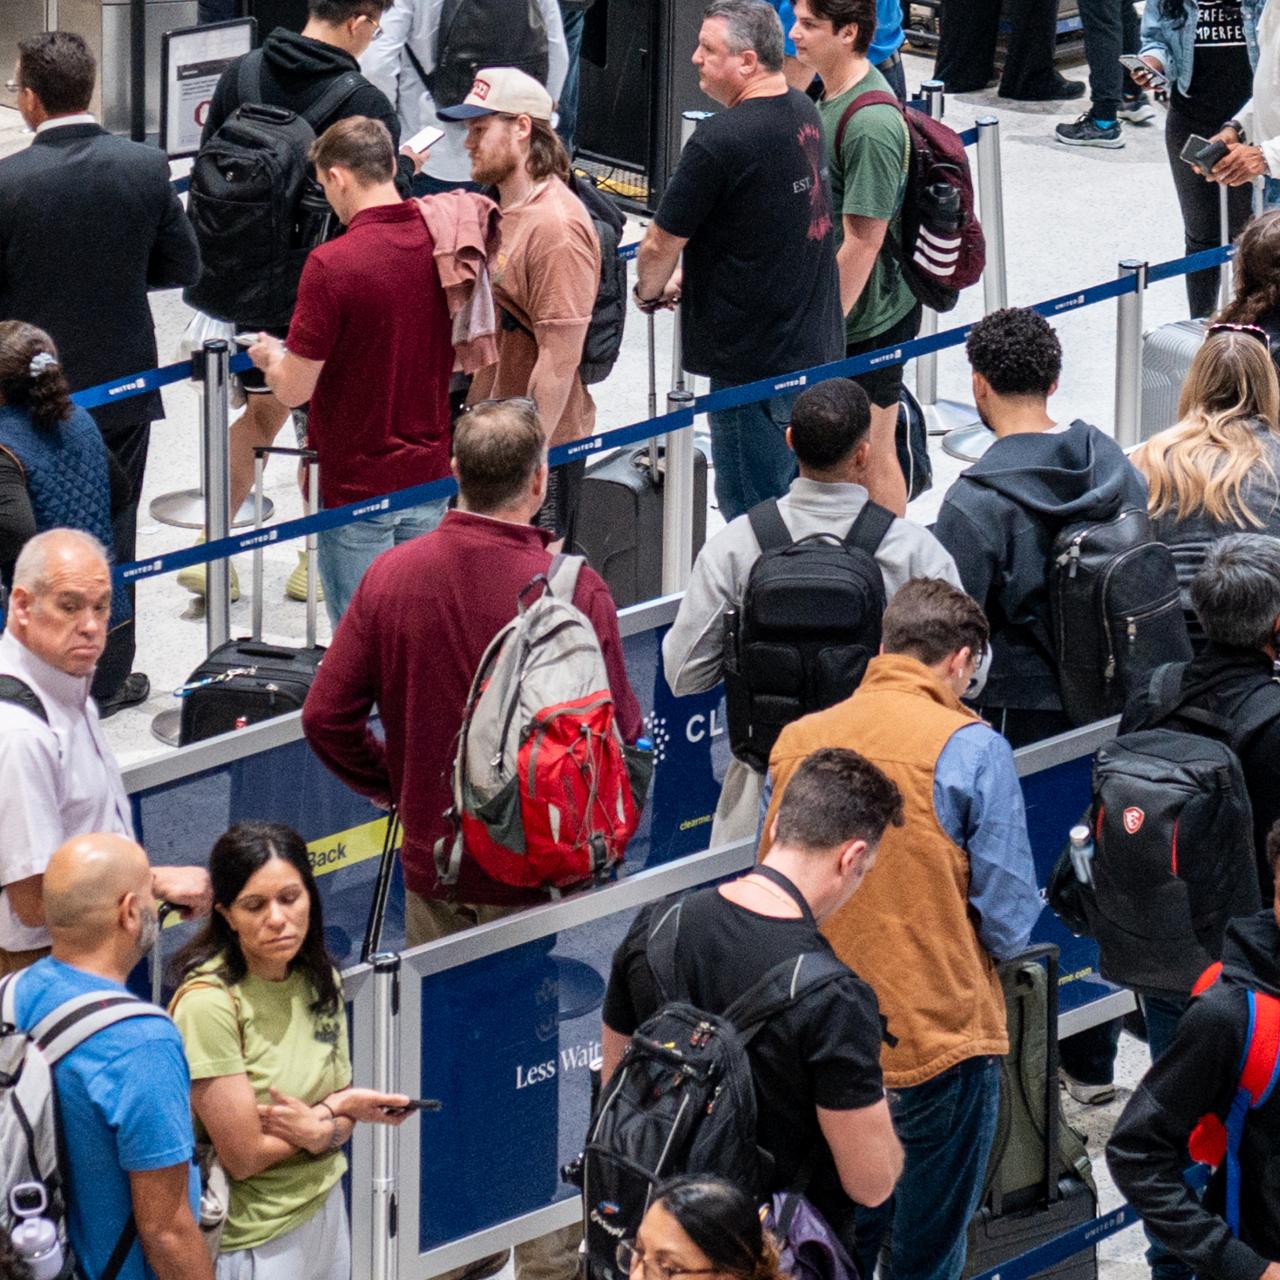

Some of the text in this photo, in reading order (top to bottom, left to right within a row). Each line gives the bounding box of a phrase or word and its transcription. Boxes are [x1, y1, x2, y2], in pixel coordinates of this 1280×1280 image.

[1196, 25, 1242, 40] MPERFE
[1055, 298, 1077, 310] UNITED
[870, 353, 895, 365] UNITED
[109, 381, 136, 396] UNITED
[774, 378, 799, 390] UNITED
[568, 441, 595, 455] UNITED
[352, 502, 381, 516] UNITED
[240, 535, 269, 548] UNITED
[123, 564, 153, 578] UNITED
[679, 813, 714, 831] clearme.
[1058, 967, 1093, 986] rme.com
[515, 1041, 602, 1089] Less Wait
[1085, 1218, 1116, 1240] UNITED
